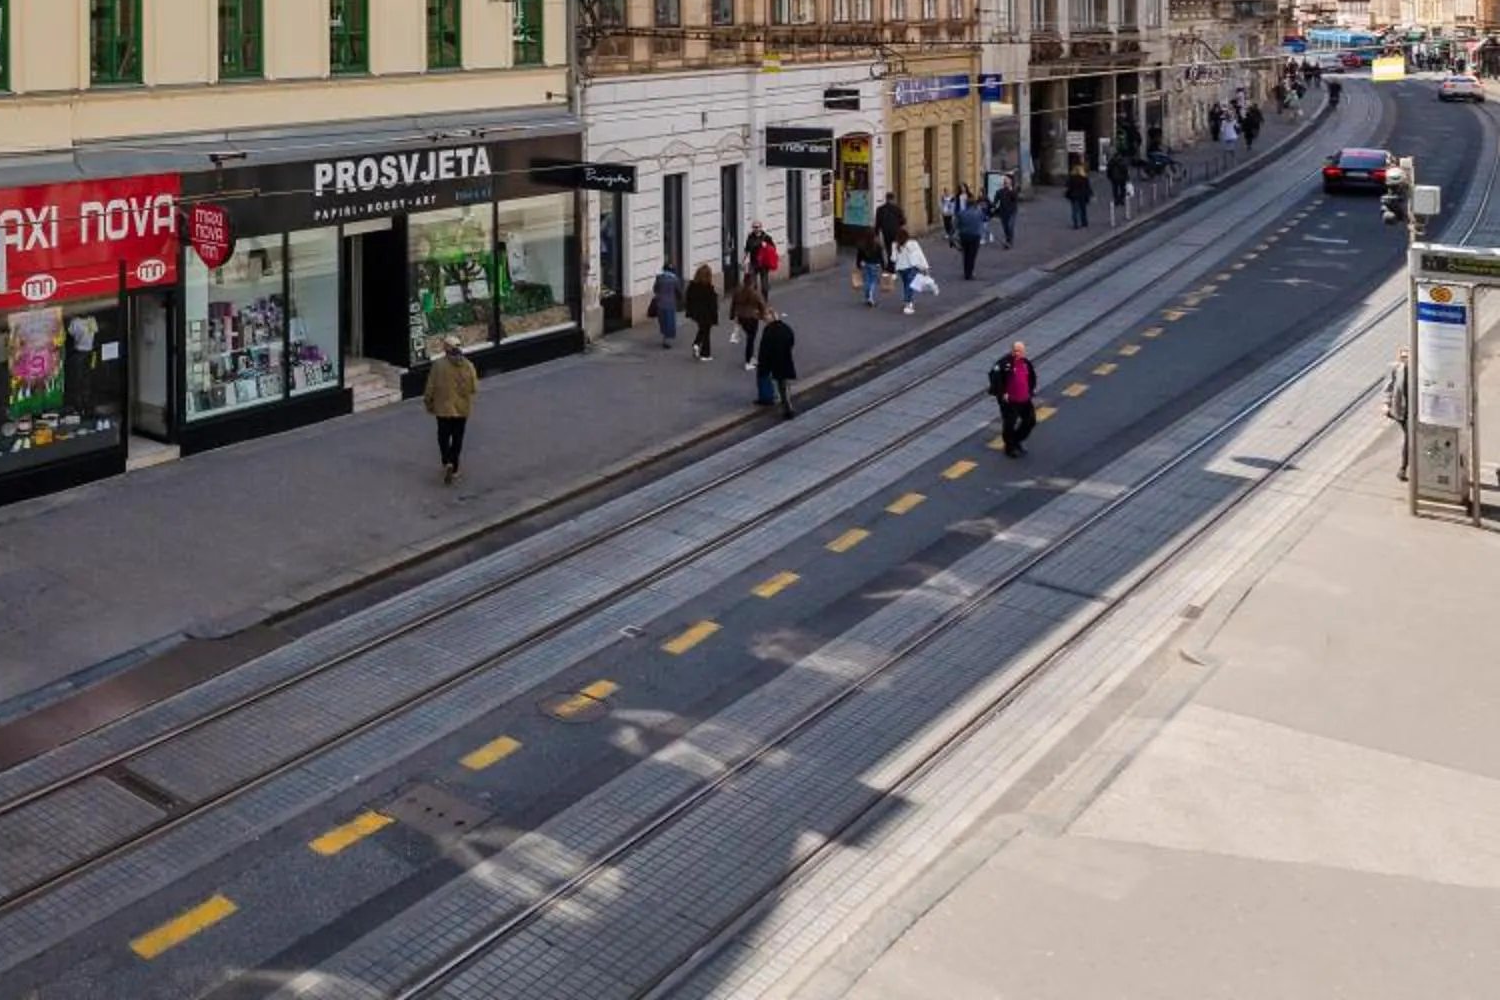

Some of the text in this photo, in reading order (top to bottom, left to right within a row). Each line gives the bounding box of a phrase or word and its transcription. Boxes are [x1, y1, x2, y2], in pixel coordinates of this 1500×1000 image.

[314, 146, 492, 198] PROSVJETA
[80, 193, 177, 244] NOVA
[415, 194, 437, 207] ART
